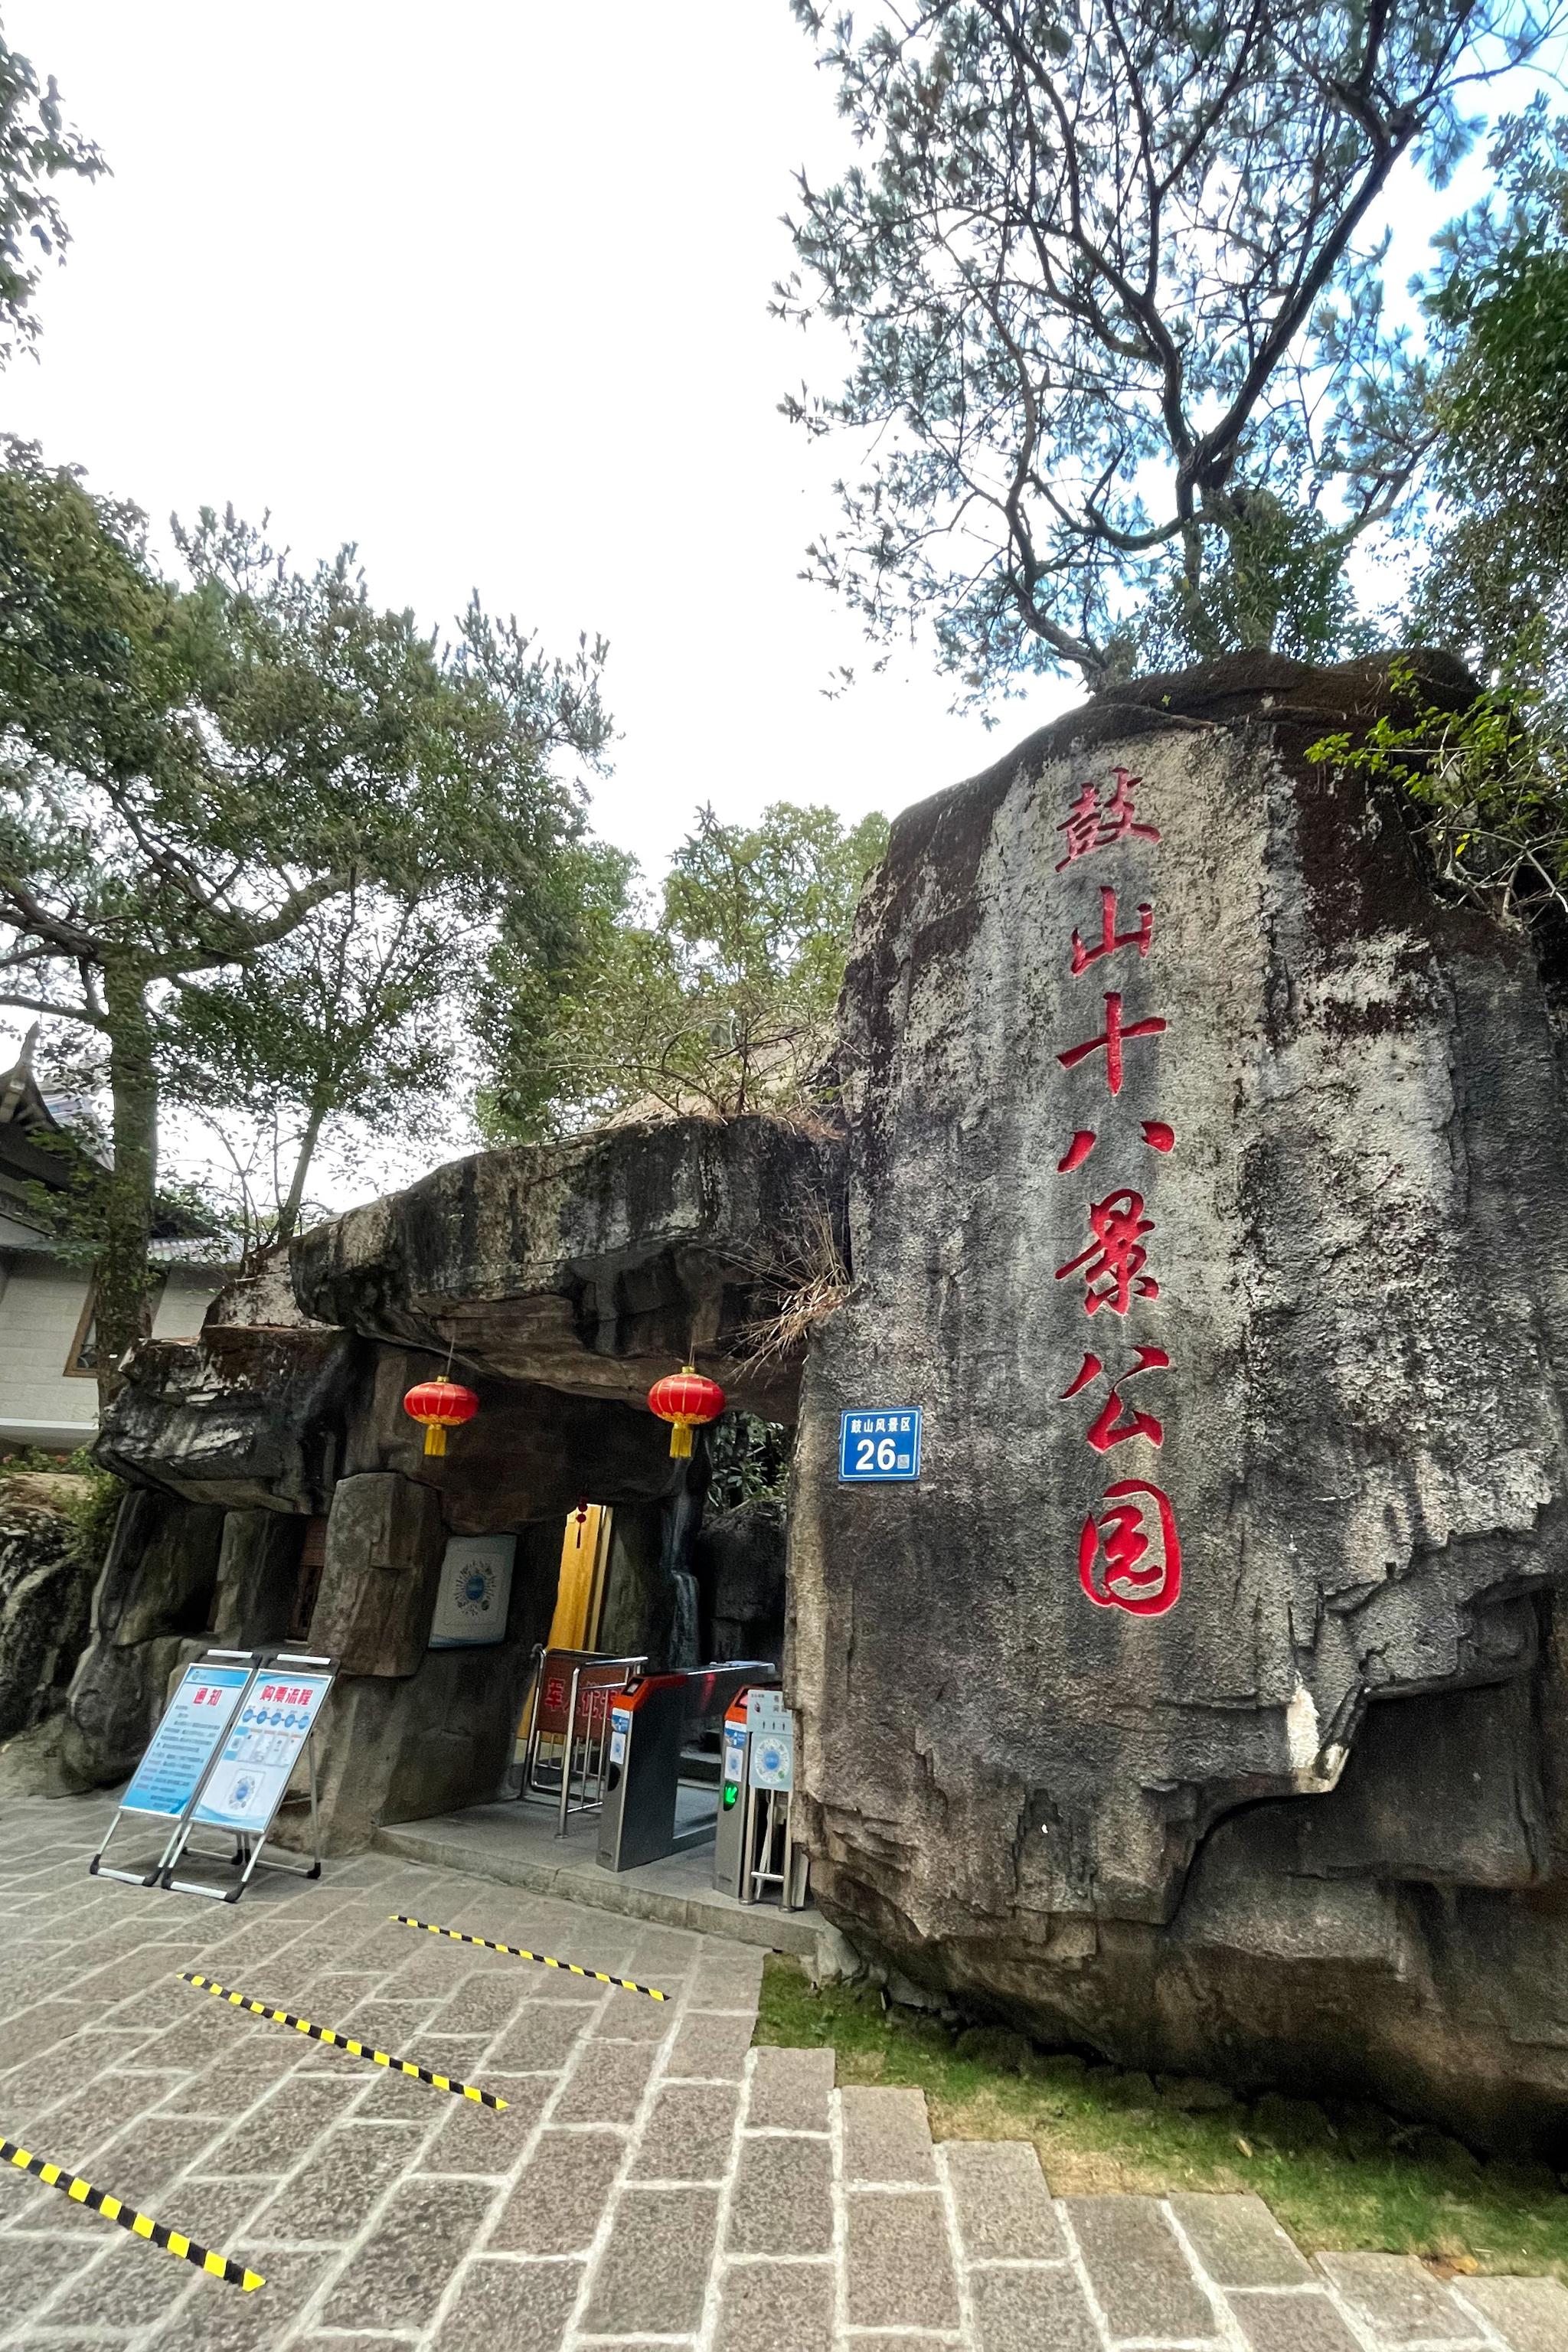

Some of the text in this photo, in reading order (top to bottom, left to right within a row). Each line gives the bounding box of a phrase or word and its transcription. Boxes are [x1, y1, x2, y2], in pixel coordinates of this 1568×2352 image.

[1055, 767, 1182, 1615] 鼓山十八景公园
[851, 1416, 911, 1433] 鼓山风景区
[856, 1438, 896, 1471] 26
[193, 1687, 223, 1707] 通知
[260, 1685, 313, 1706] 购票流程
